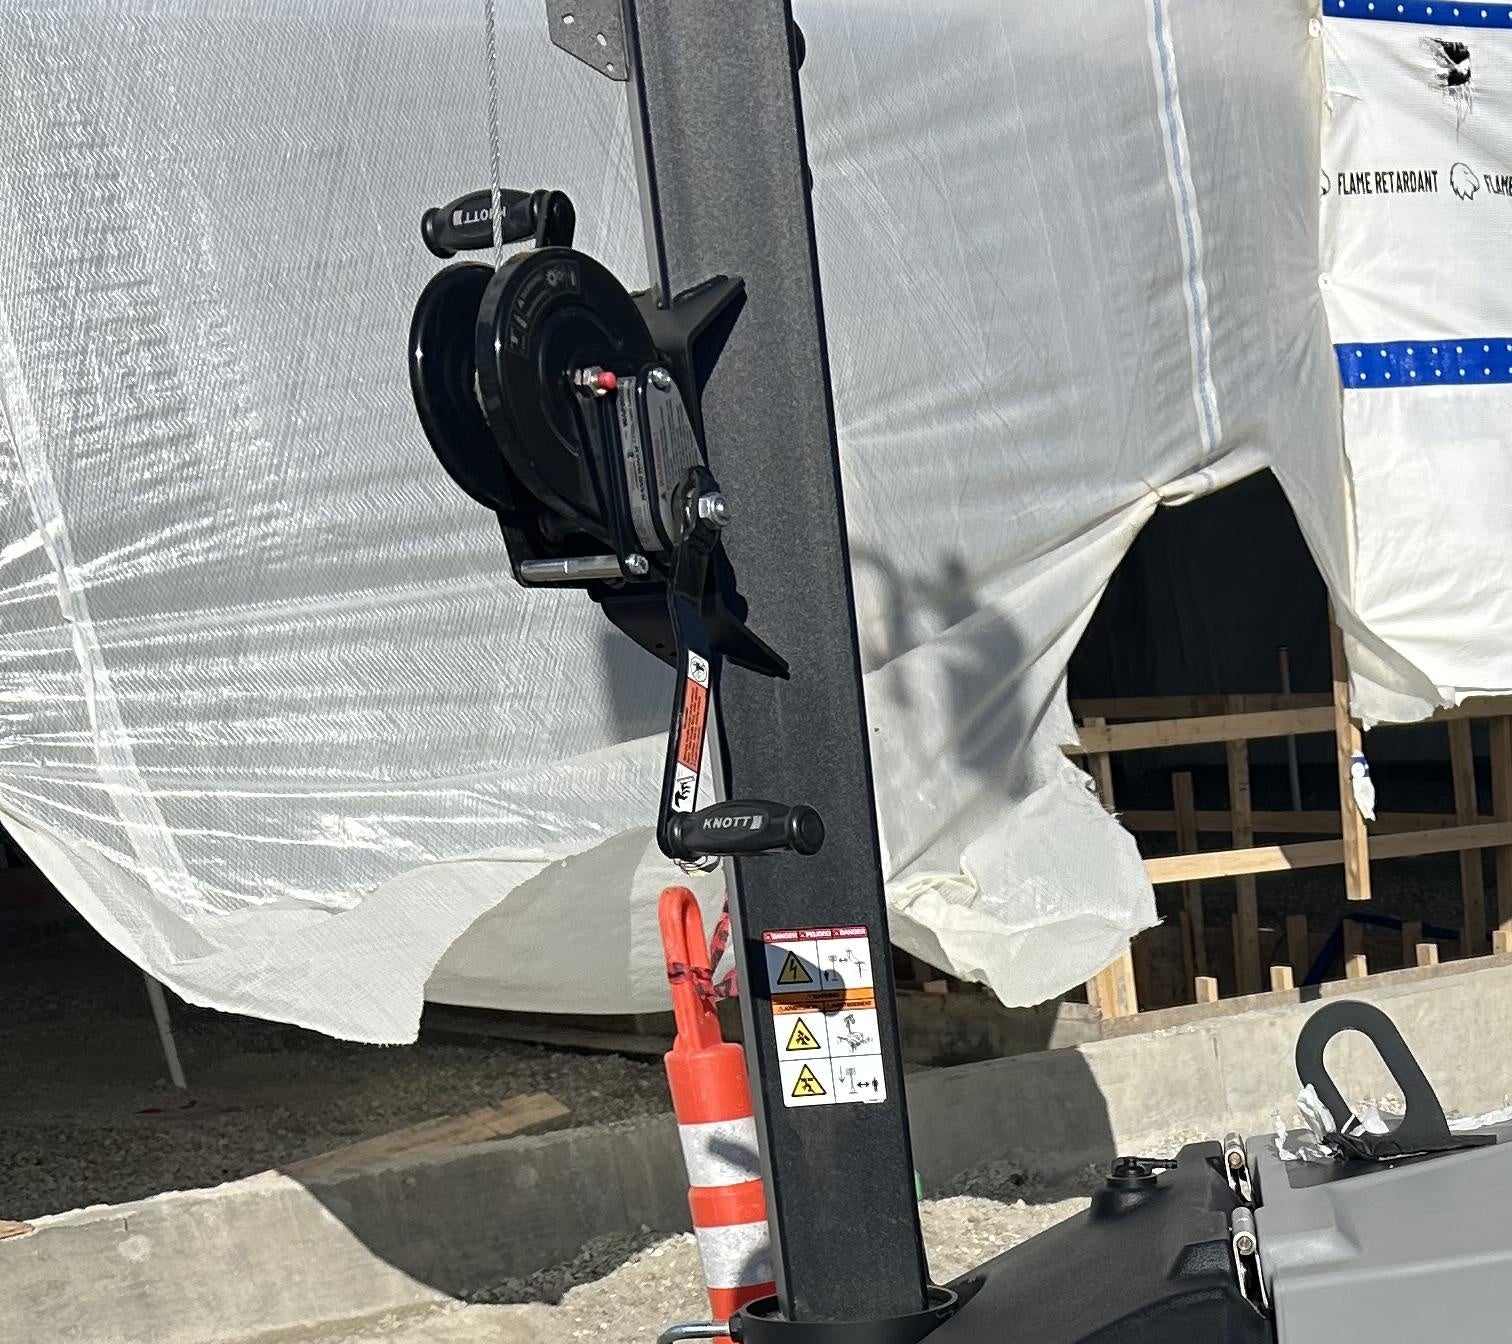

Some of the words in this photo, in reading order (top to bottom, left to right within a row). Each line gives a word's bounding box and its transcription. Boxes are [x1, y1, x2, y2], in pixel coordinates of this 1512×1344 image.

[1338, 172, 1372, 195] FLAME
[1374, 170, 1438, 194] RETARDANT
[702, 815, 752, 830] KNOTT
